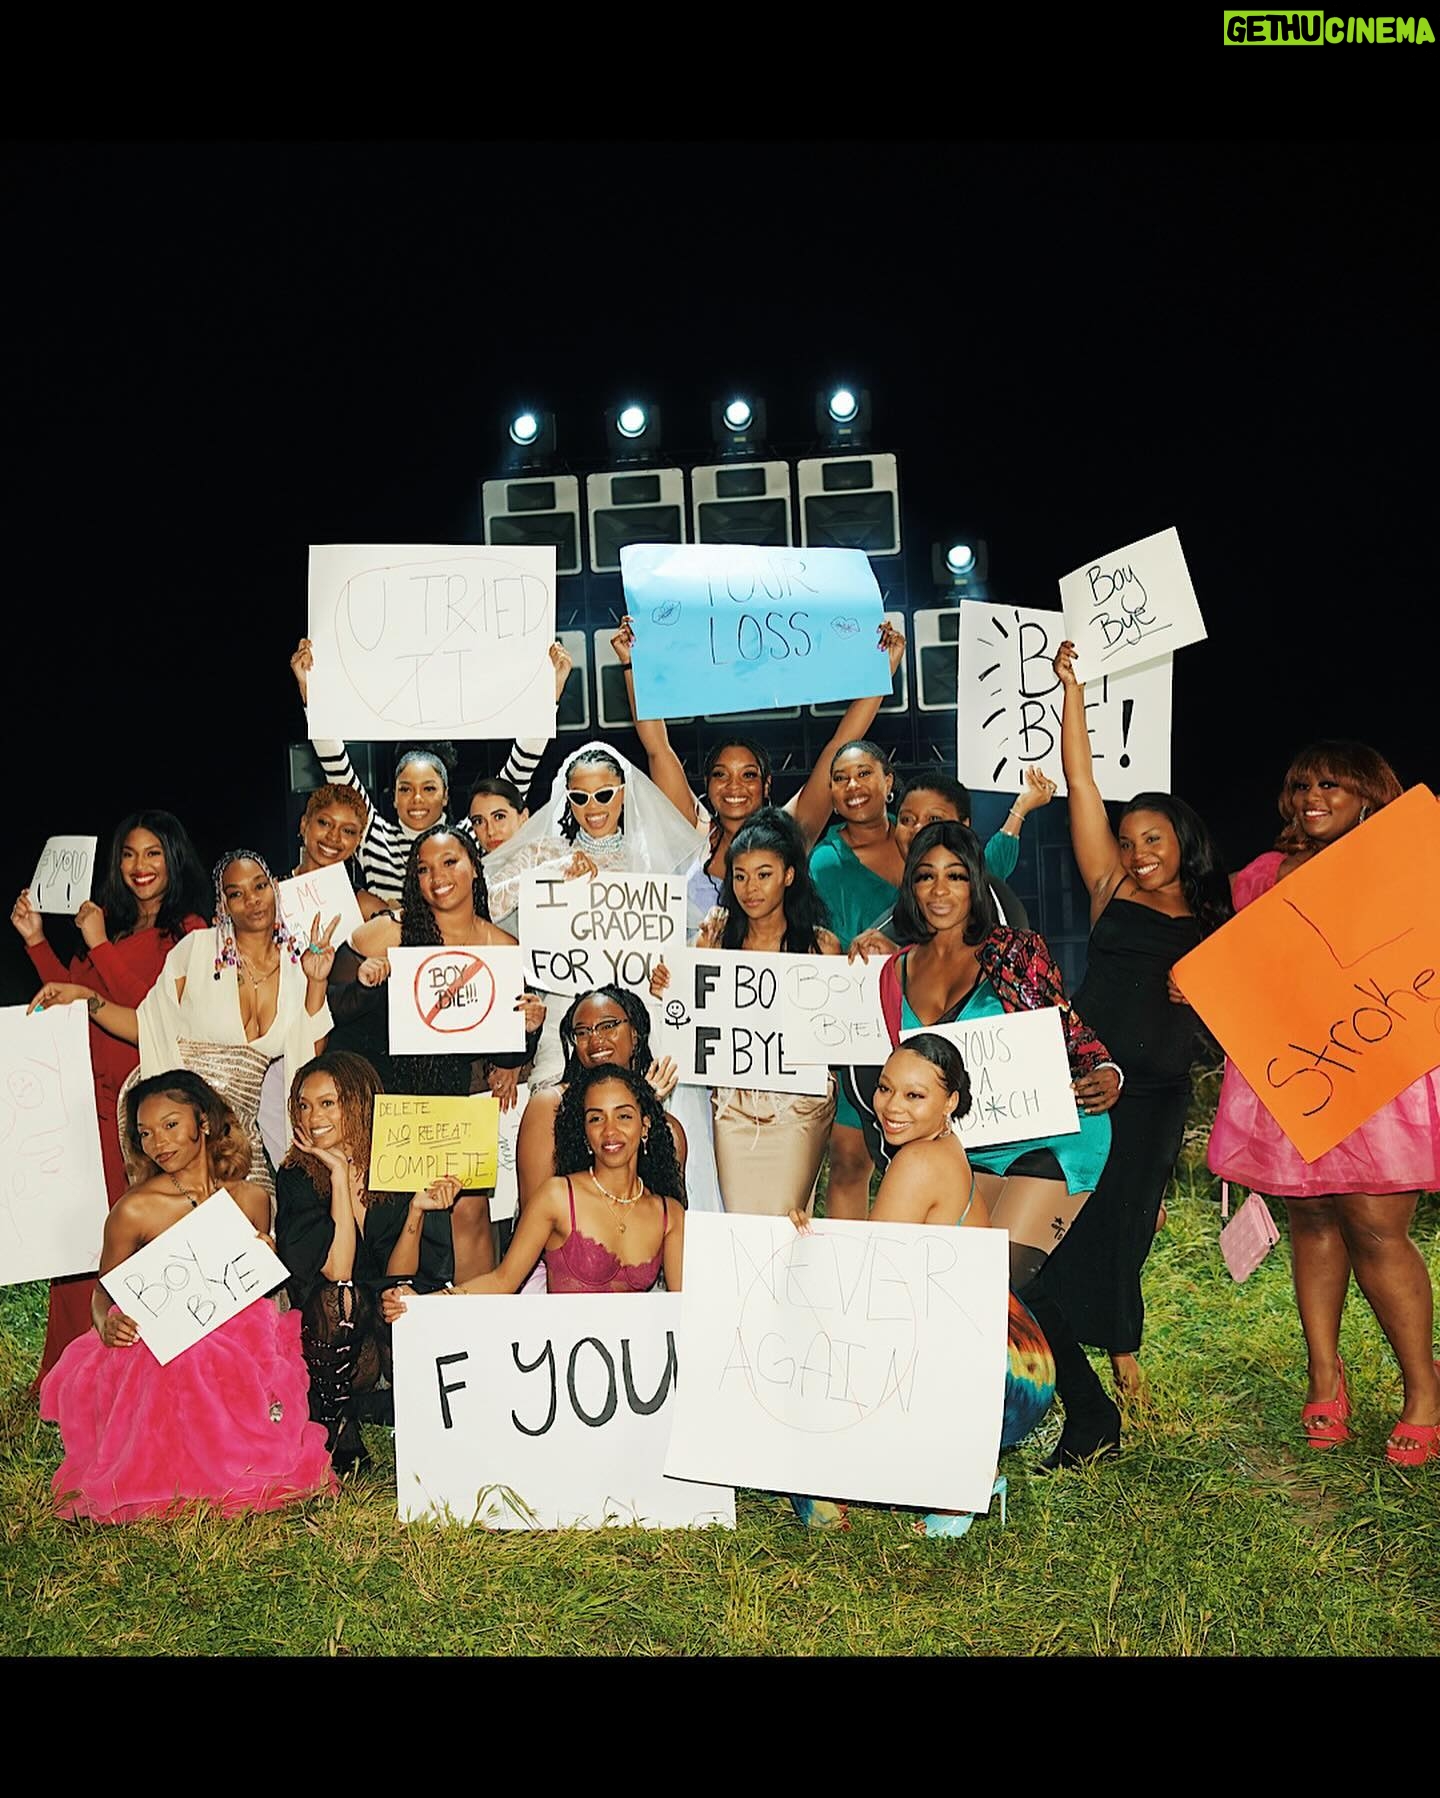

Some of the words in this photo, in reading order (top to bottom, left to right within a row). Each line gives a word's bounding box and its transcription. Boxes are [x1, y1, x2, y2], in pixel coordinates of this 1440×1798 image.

[347, 579, 387, 651] U
[409, 574, 549, 639] TRIED
[710, 611, 812, 665] LOSS
[395, 649, 473, 728] IT
[535, 879, 568, 909] I
[590, 881, 682, 912] DOWN-
[571, 911, 674, 943] GRADED
[428, 963, 468, 989] BOY
[531, 949, 595, 985] FOR
[694, 963, 722, 1009] F
[735, 964, 777, 1009] BO
[434, 982, 479, 1010] BYE!!!
[694, 1026, 722, 1075] F
[732, 1027, 797, 1076] BYE
[379, 1101, 431, 1118] DELETE
[387, 1124, 411, 1143] NO
[123, 1239, 211, 1319] BOY
[187, 1251, 261, 1328] BYE
[729, 1224, 984, 1337] NEVER
[435, 1350, 469, 1429] F
[718, 1326, 920, 1416] AGAIN
